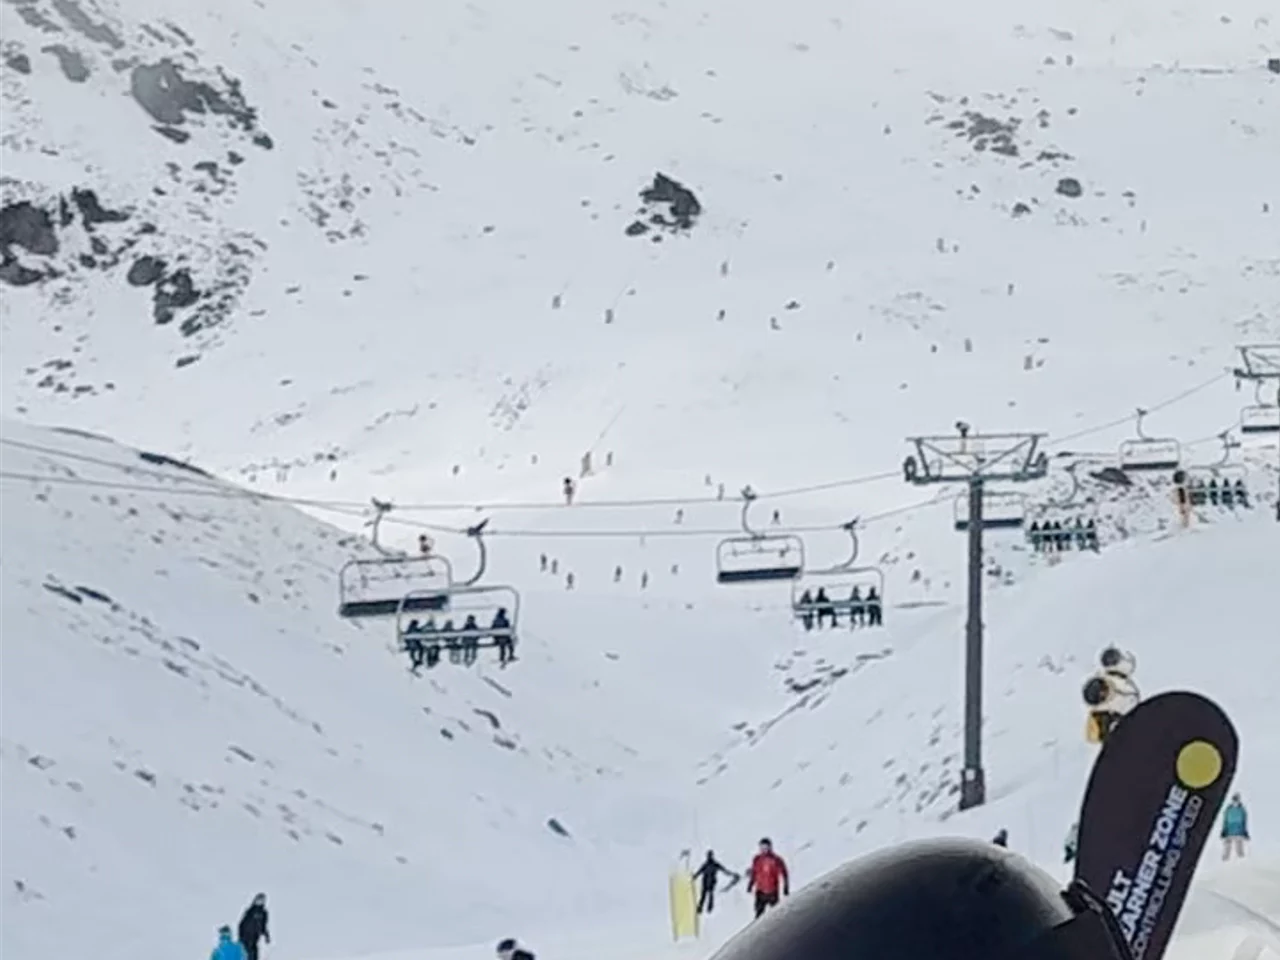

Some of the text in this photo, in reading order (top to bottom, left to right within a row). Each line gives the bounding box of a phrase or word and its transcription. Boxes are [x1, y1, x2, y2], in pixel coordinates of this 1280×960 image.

[1150, 784, 1188, 850] ZONE
[1172, 795, 1203, 847] SPEED
[1106, 870, 1132, 915] ULT
